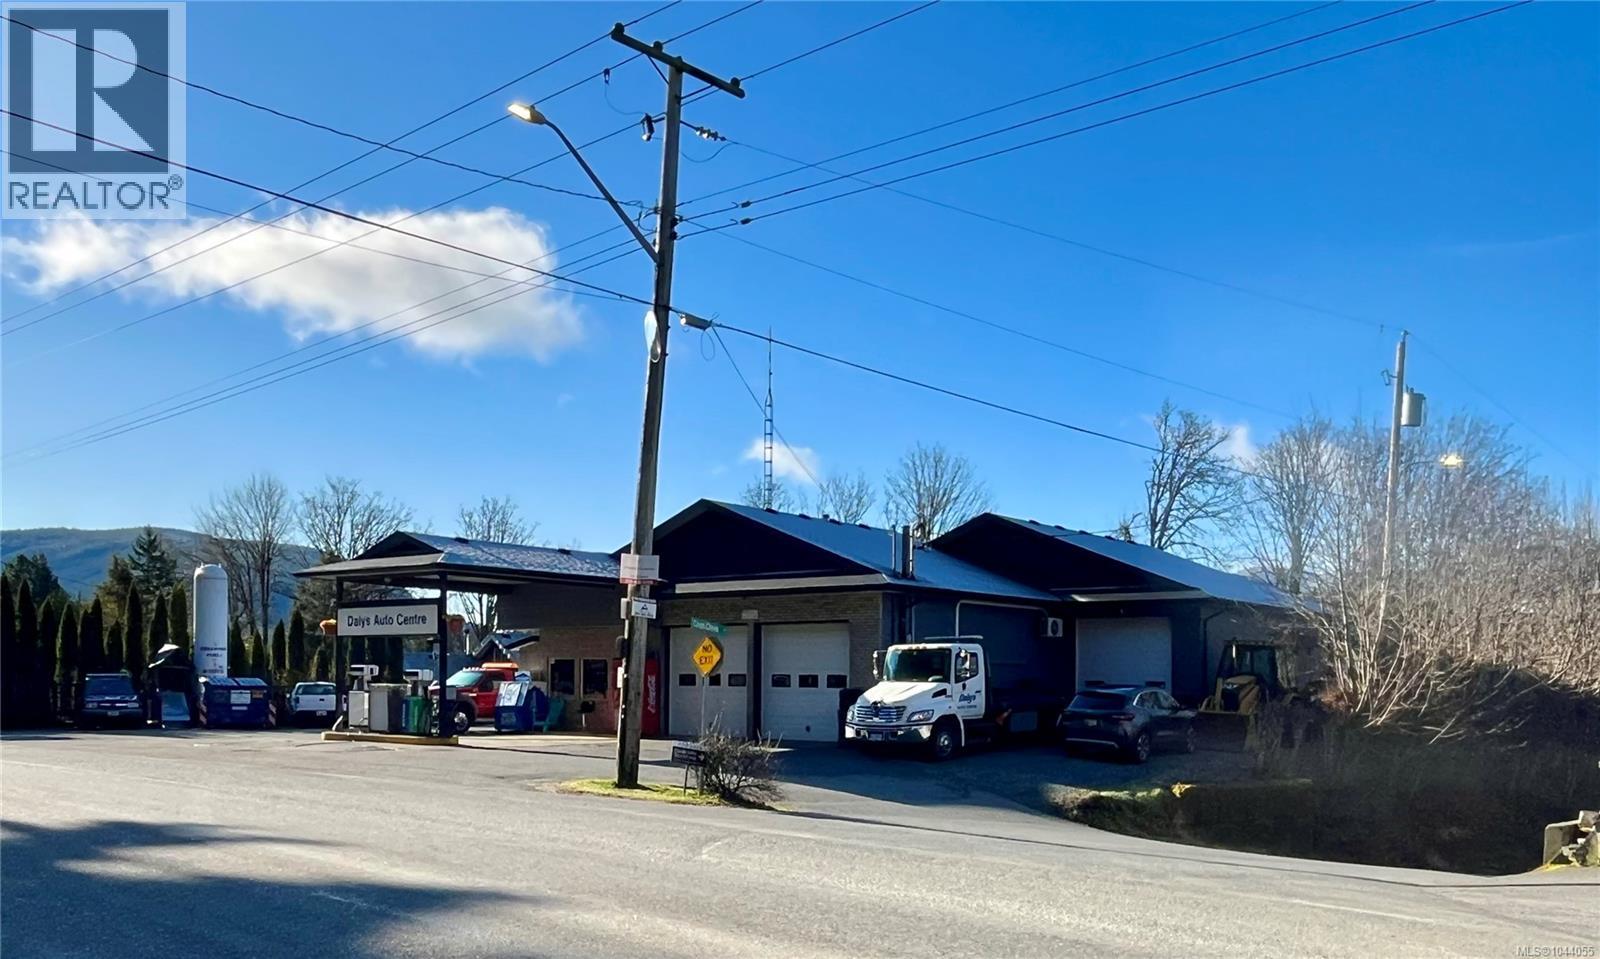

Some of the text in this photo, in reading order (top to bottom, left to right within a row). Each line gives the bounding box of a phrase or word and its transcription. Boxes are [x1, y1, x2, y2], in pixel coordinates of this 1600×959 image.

[373, 614, 394, 626] Auto
[396, 613, 427, 626] Centre
[702, 644, 713, 654] NO
[699, 656, 714, 666] EXIT
